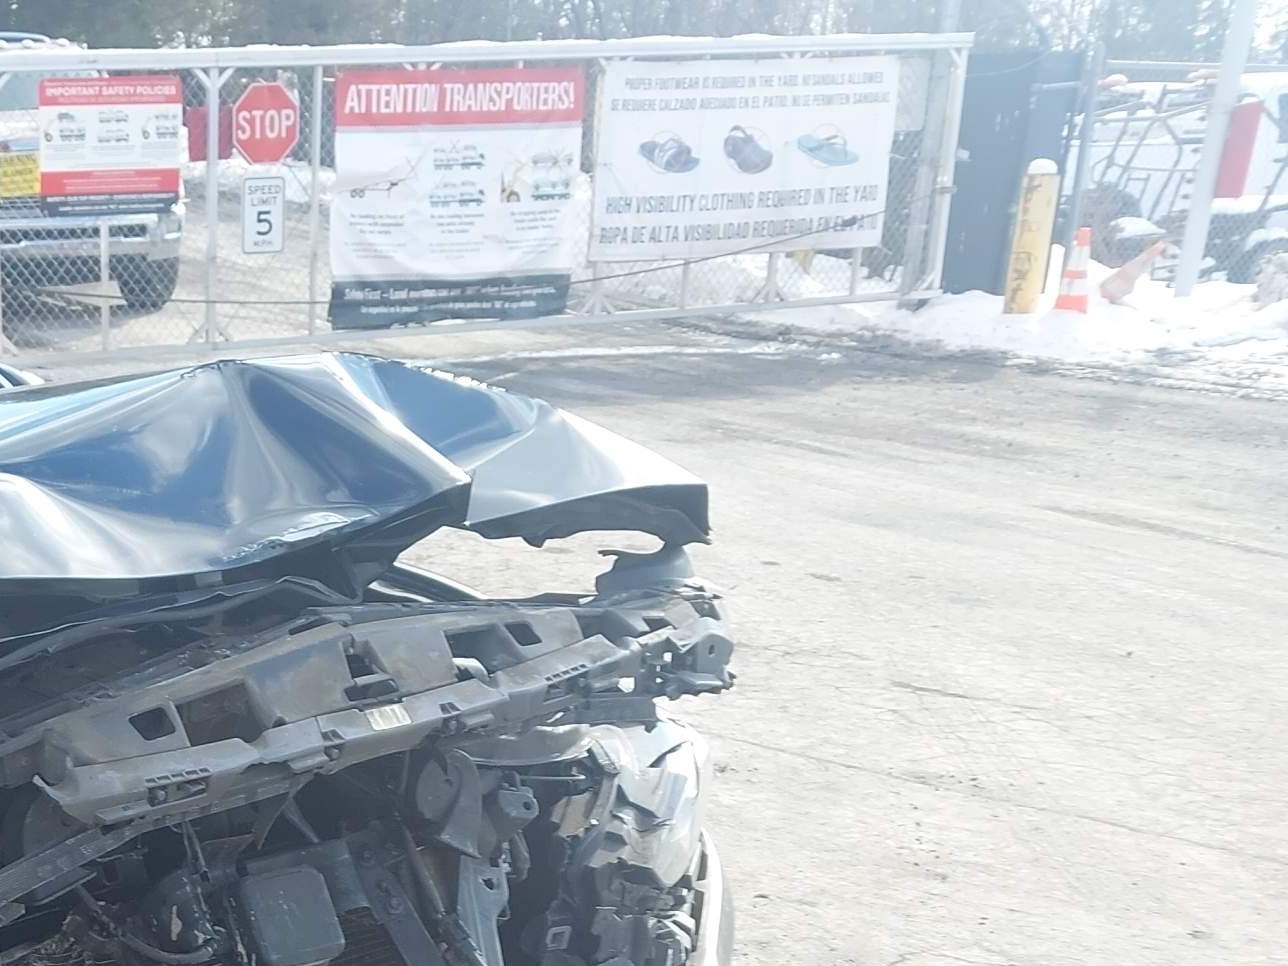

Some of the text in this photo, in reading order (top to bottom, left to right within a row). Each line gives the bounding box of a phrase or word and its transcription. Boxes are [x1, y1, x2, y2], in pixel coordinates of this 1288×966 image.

[45, 84, 177, 97] IMPORTANT SAFETY POLICIES
[655, 77, 699, 90] FOOTWEAR
[759, 75, 775, 87] THE
[344, 82, 575, 114] ATTENTION TRANSPORTERS!
[658, 98, 697, 110] CALZADO
[237, 109, 295, 140] STOP
[247, 184, 281, 196] SPEED
[251, 196, 278, 207] LIMIT
[606, 196, 632, 214] HIGH
[636, 195, 696, 213] VISIBILITY
[698, 192, 754, 211] CLOTHING
[756, 189, 811, 208] REQUIRED
[814, 188, 825, 205] IN
[828, 186, 850, 203] THE
[255, 210, 273, 236] 5
[600, 227, 628, 244] ROPA
[632, 226, 647, 243] DE
[648, 225, 679, 243] ALTA
[684, 222, 749, 241] VISIBILIDAD
